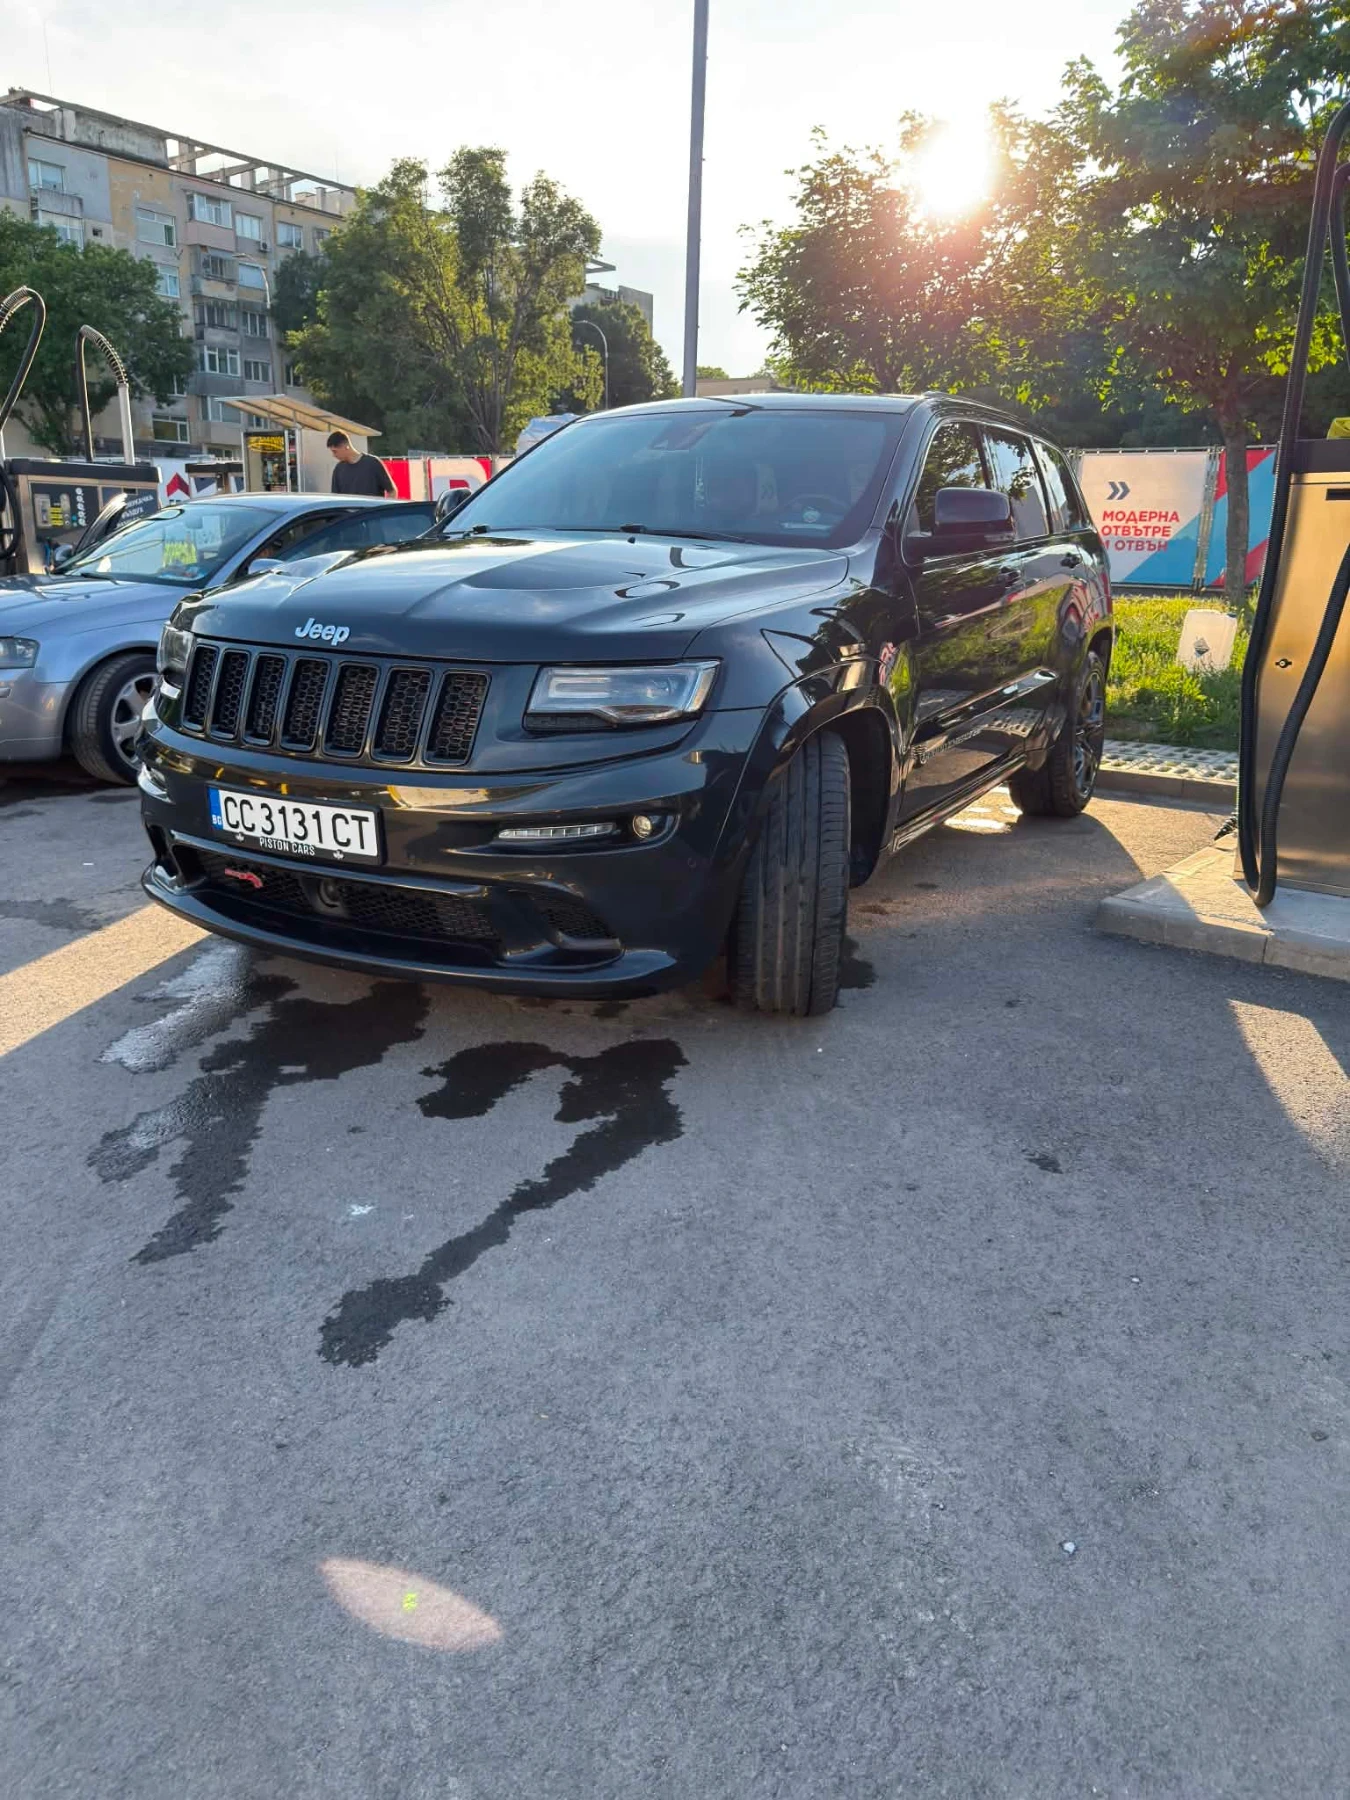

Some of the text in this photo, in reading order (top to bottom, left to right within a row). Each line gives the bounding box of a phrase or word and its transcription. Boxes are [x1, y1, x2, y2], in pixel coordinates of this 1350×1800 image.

[1102, 510, 1180, 524] МОДЕРНА
[1101, 525, 1172, 537] ОТВЪТРЕ
[1114, 540, 1168, 552] ОТВЪН
[294, 617, 350, 646] Jeep
[211, 814, 222, 826] BG
[259, 836, 316, 856] PISTON CARS
